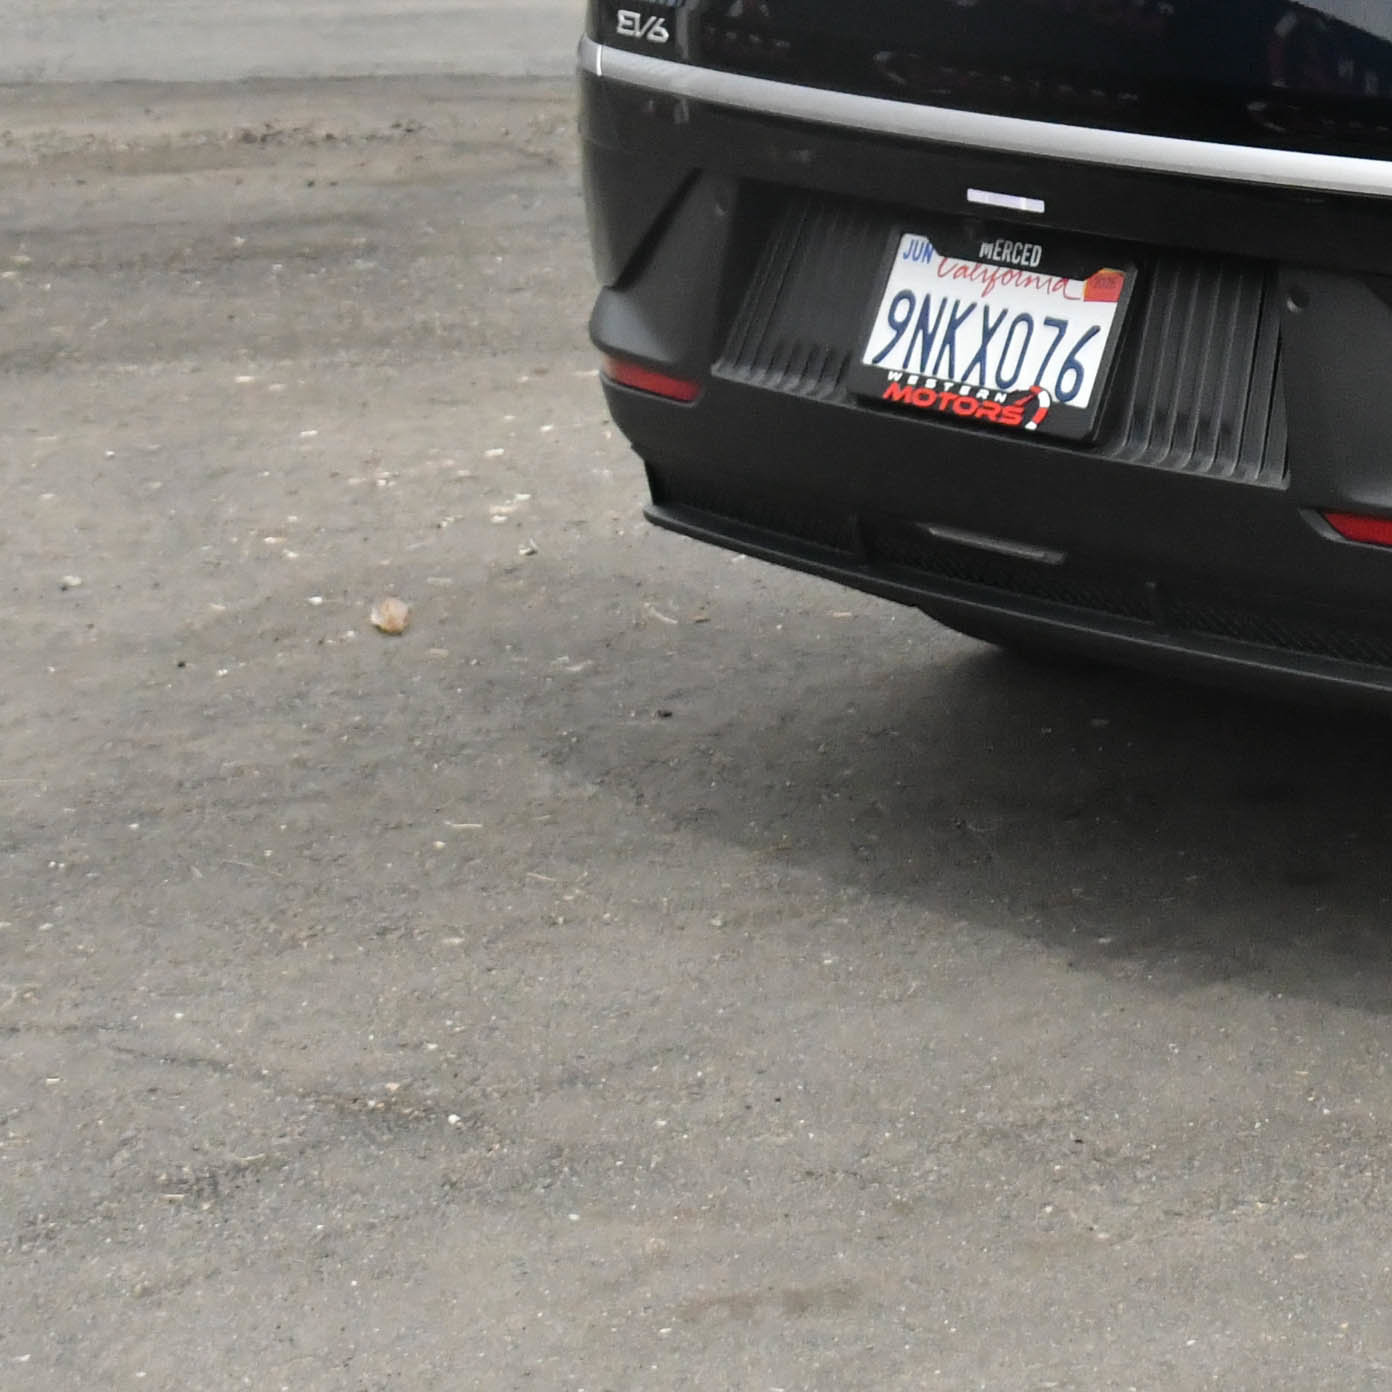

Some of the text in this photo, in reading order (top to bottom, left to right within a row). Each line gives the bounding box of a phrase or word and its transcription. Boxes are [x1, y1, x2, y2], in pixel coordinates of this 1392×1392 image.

[616, 8, 670, 44] EV6
[902, 239, 934, 265] JUN
[936, 257, 1081, 300] California
[872, 288, 1101, 403] 9NKX076
[883, 382, 1025, 428] MOTORS
[887, 371, 1007, 404] WESTERN
